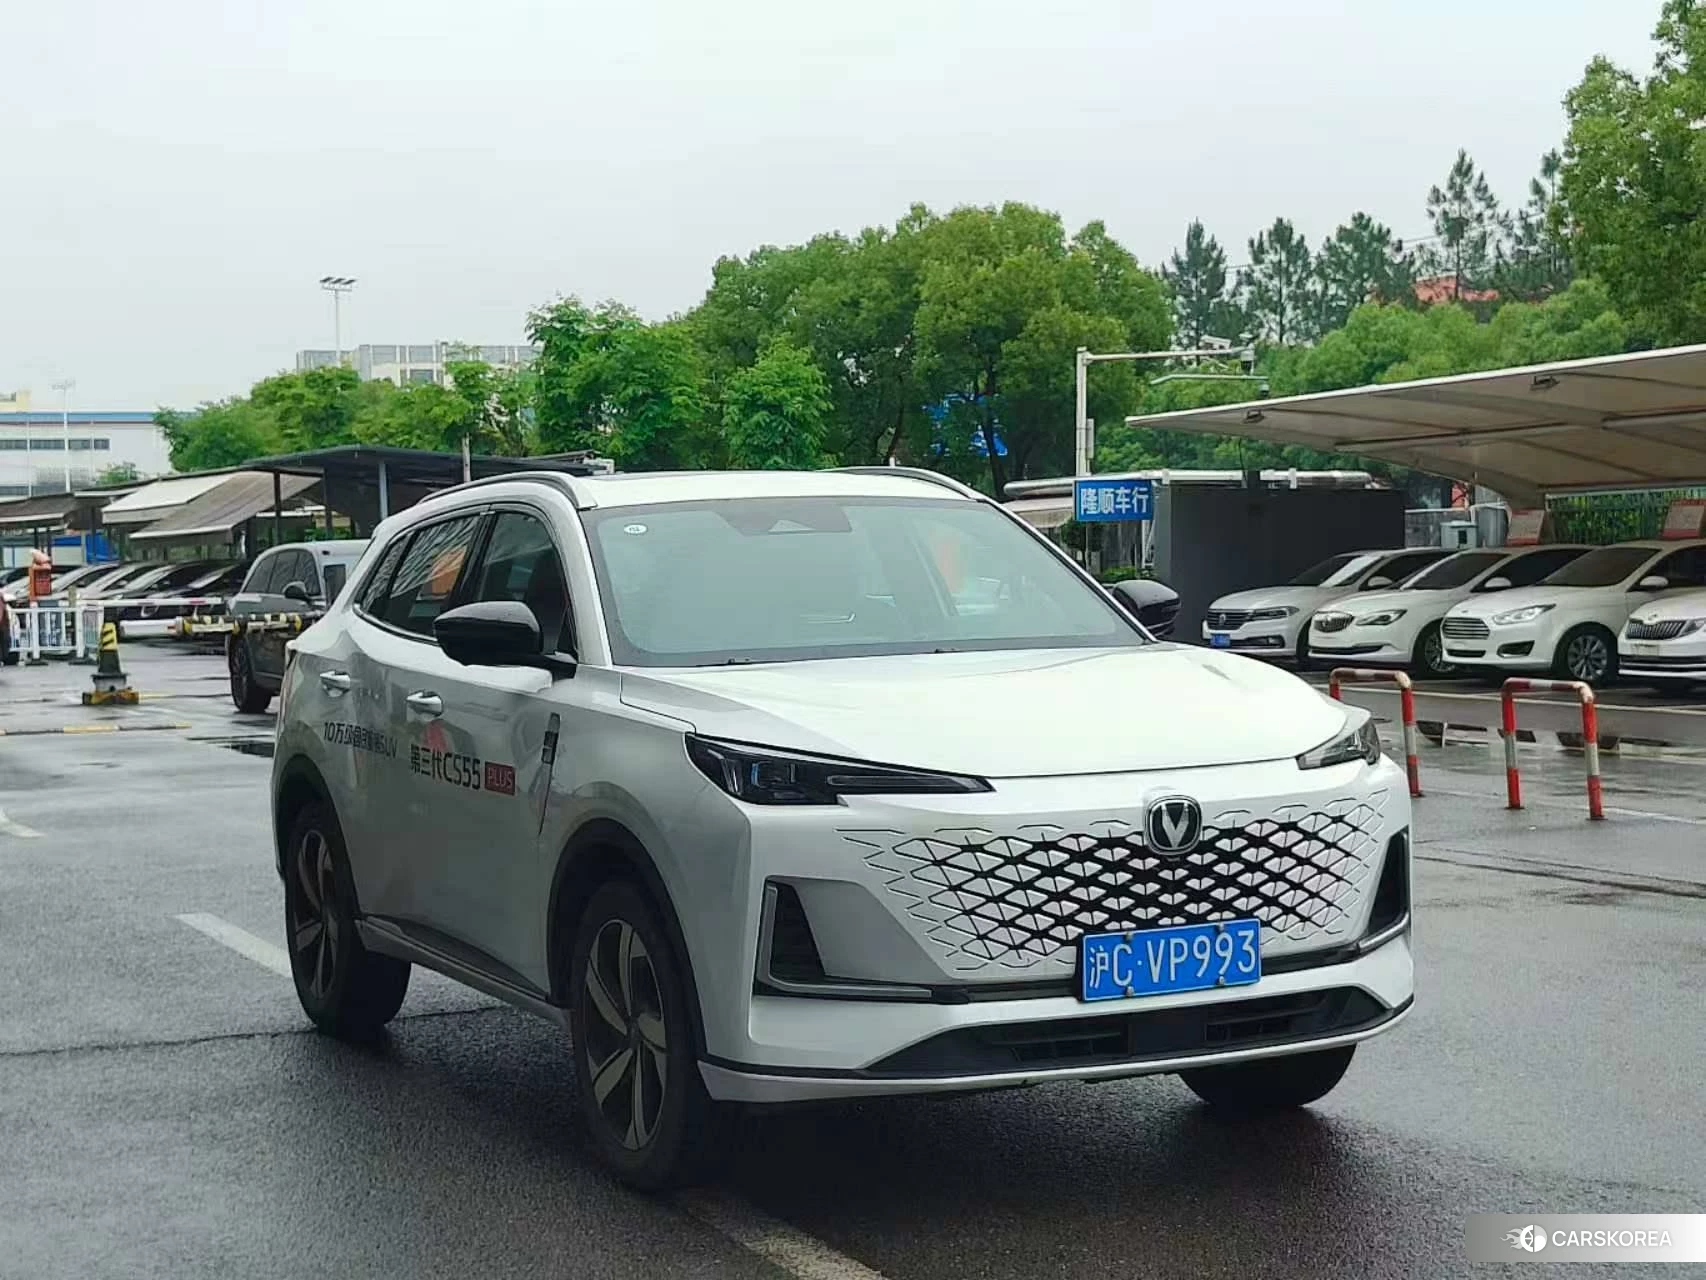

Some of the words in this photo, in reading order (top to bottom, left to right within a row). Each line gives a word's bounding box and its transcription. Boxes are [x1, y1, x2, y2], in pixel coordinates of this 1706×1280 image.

[1080, 486, 1149, 515] 隆顺车行
[486, 764, 514, 791] PLUS
[1089, 929, 1257, 989] 沪C·VP993
